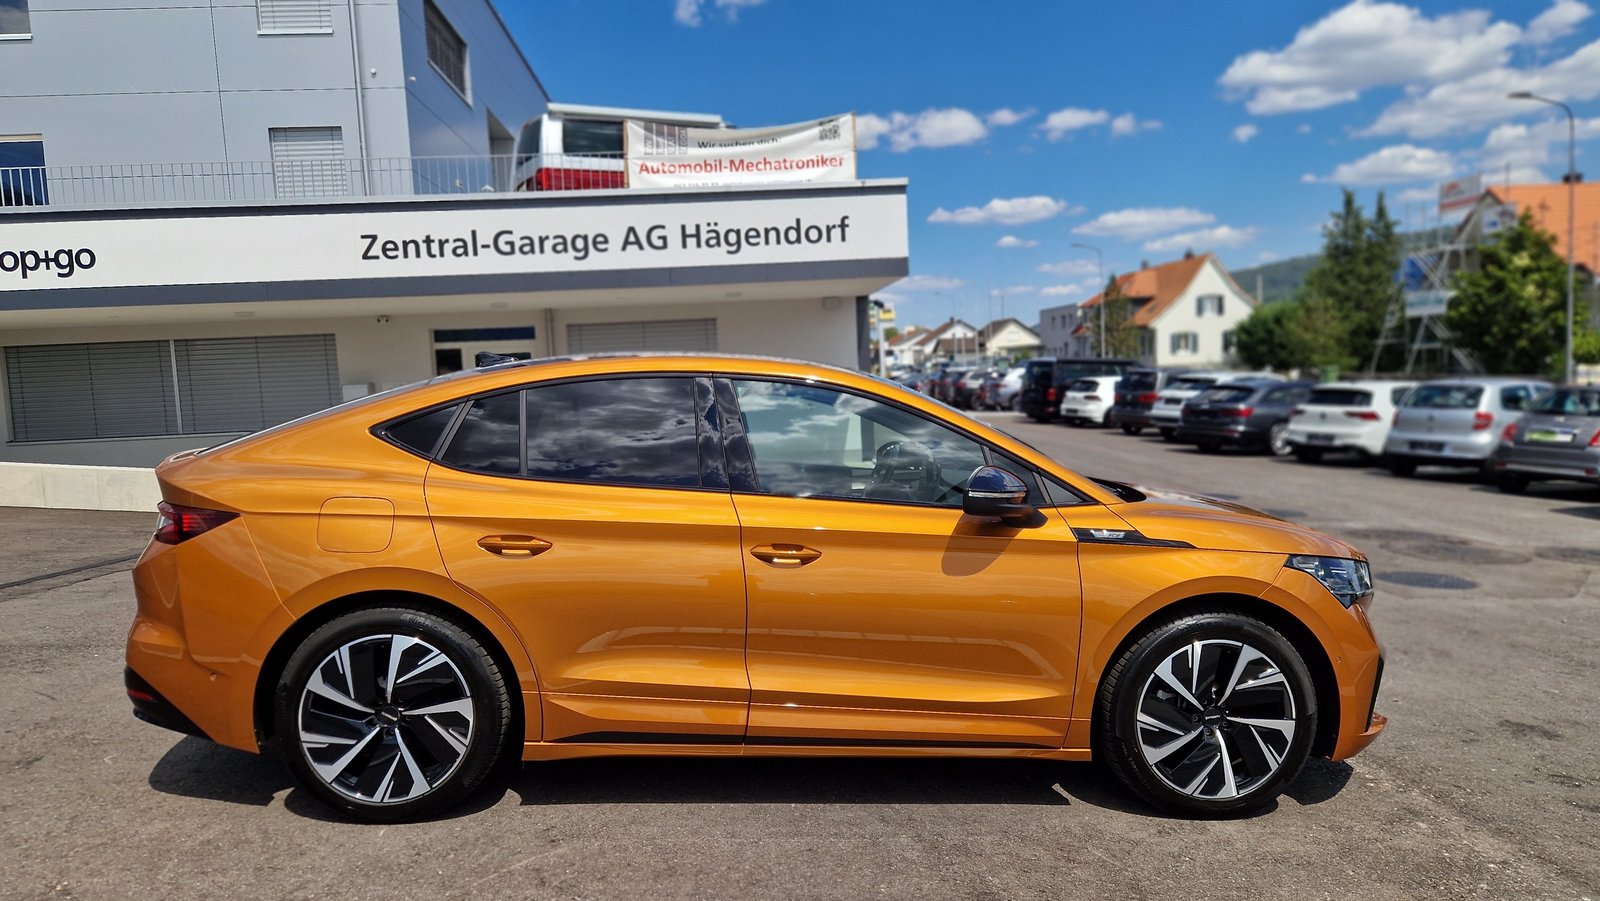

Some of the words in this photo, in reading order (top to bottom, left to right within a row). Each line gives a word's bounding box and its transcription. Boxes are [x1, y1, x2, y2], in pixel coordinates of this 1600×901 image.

[697, 140, 716, 149] Wir
[718, 140, 755, 148] suchen
[638, 154, 845, 175] Automobil-Mechatroniker
[360, 229, 610, 261] Zentral-Garage
[620, 224, 669, 252] AG
[680, 215, 850, 255] Hägendorf
[0, 247, 96, 279] op+go
